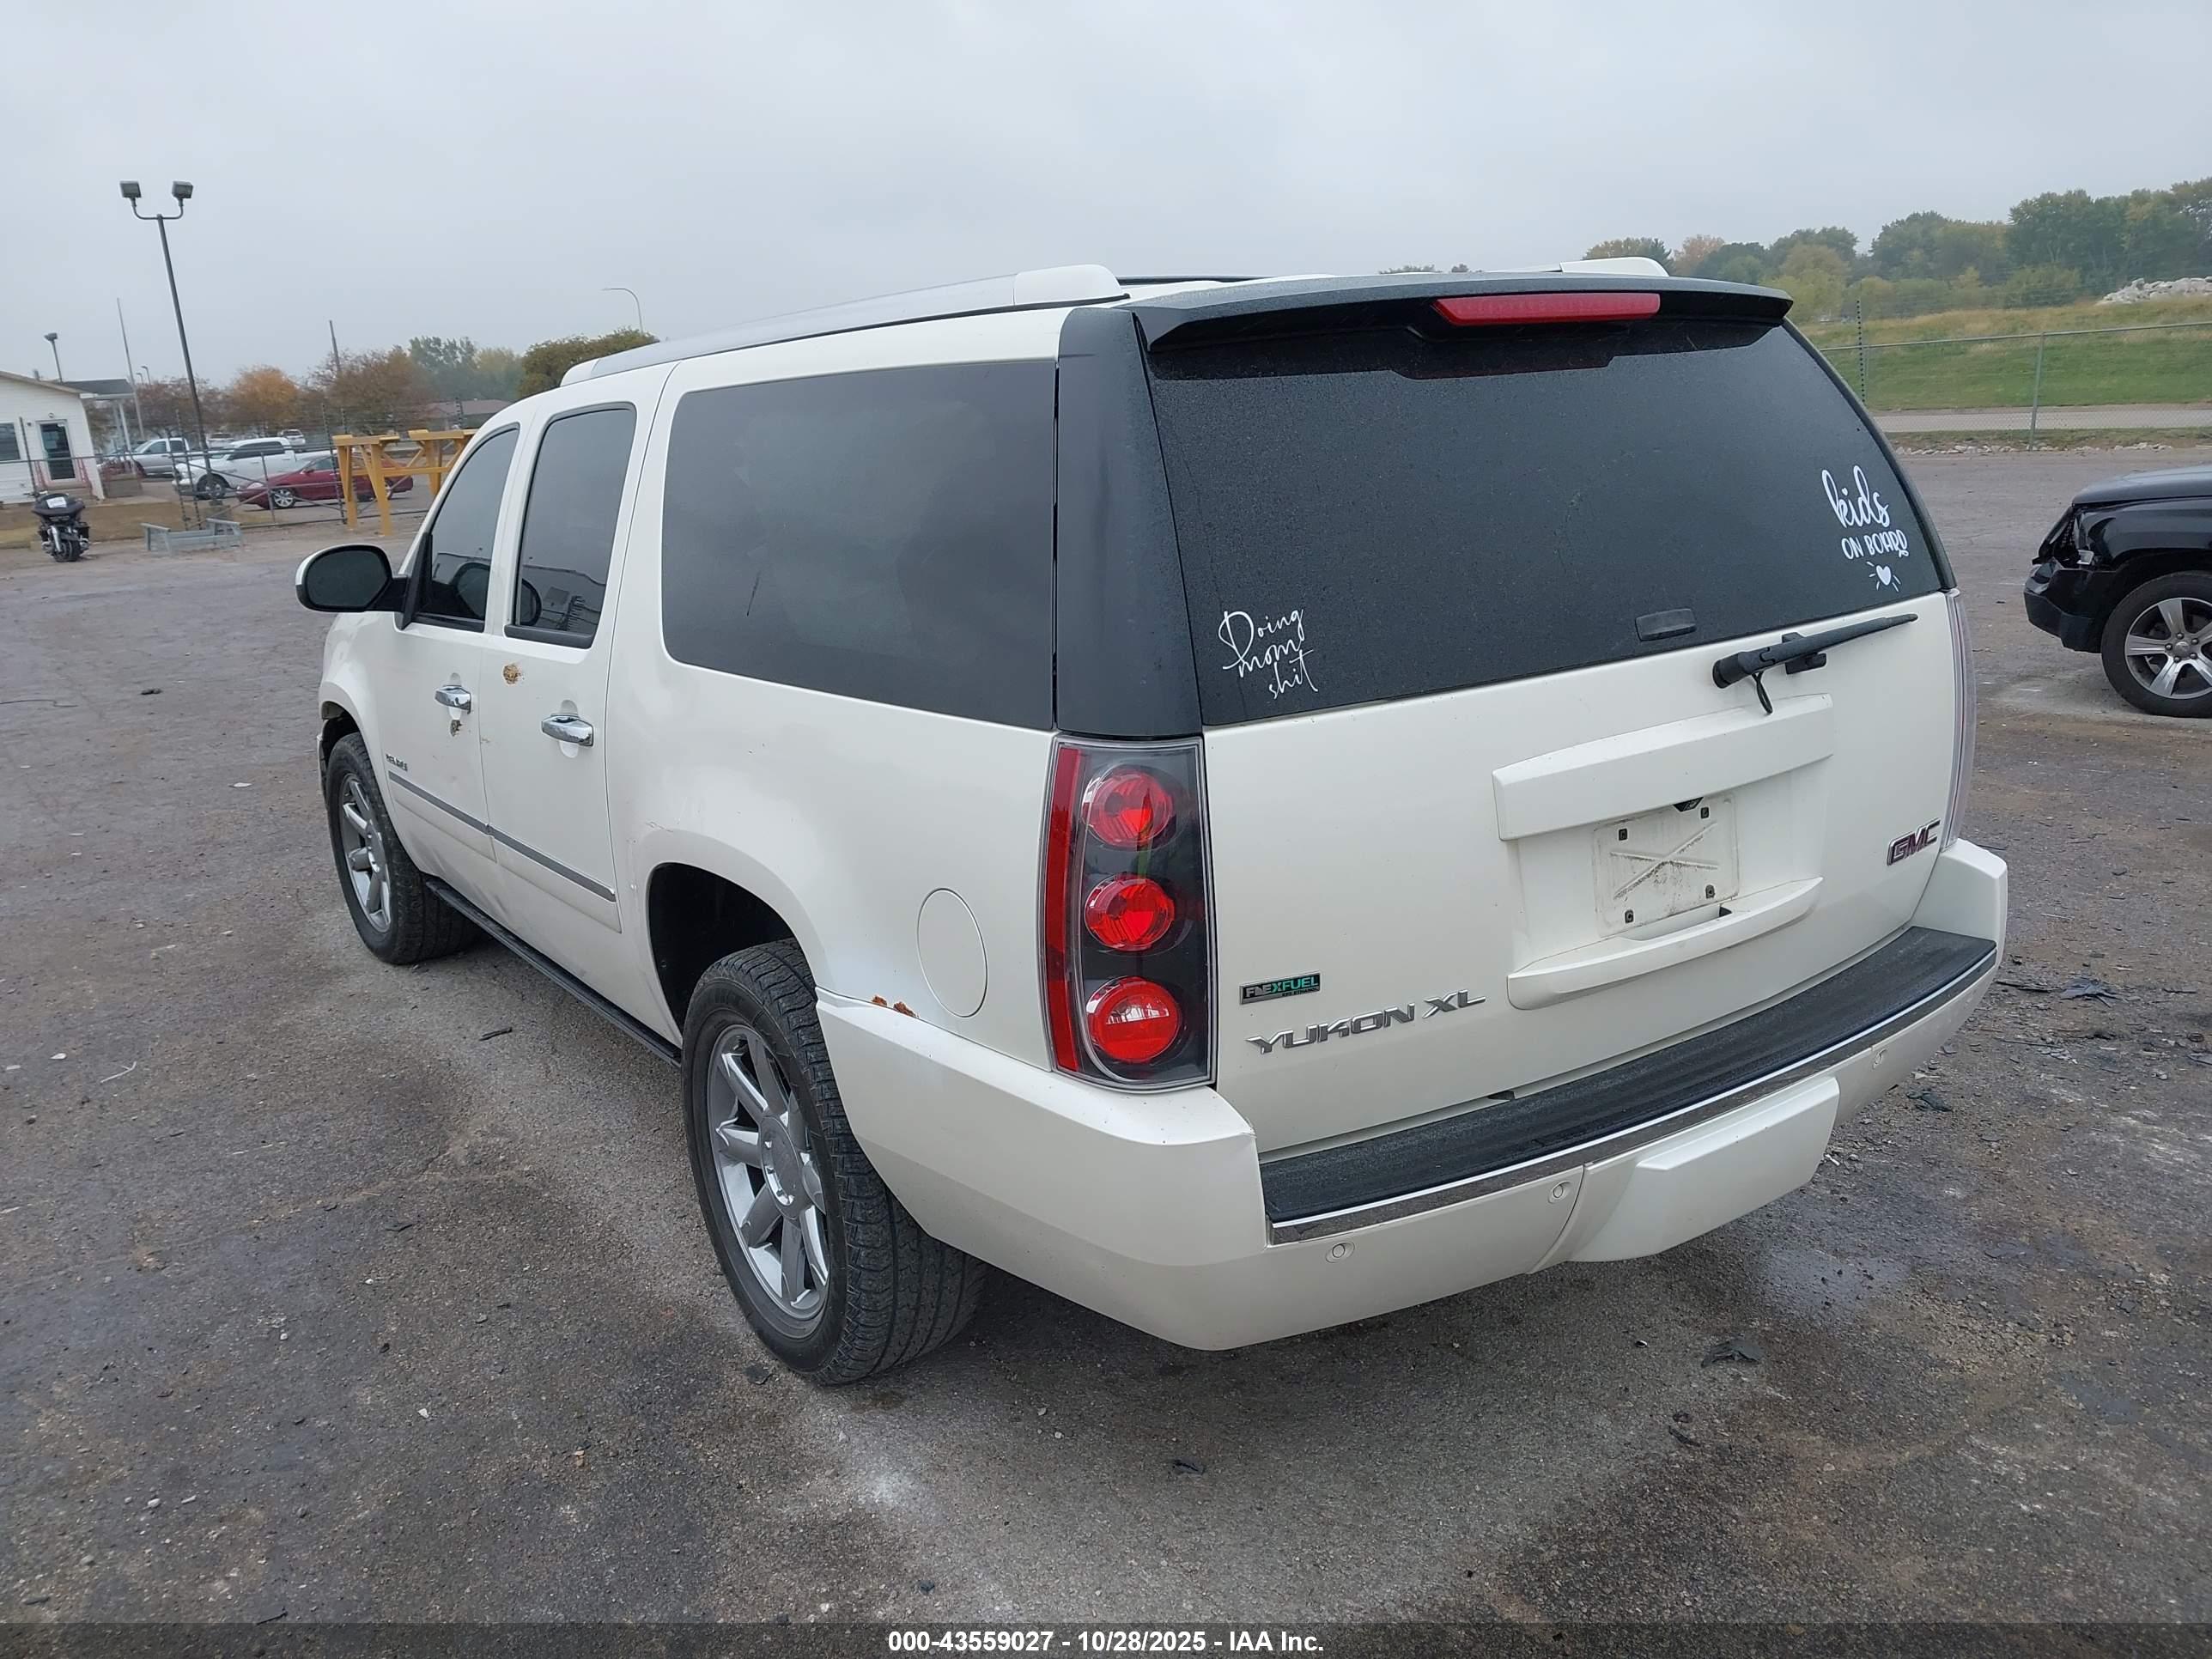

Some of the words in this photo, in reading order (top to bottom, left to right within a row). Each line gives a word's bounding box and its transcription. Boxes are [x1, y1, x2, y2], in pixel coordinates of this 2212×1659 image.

[1822, 465, 1890, 528] kids
[1841, 537, 1864, 560] ON
[1864, 530, 1909, 557] BOARD
[1218, 609, 1304, 669] Doing
[1269, 649, 1318, 699] shit
[1887, 818, 1941, 866] GMC
[1245, 975, 1319, 998] FLEXFUEL
[1245, 1003, 1415, 1054] YUKON
[1422, 989, 1486, 1018] XL
